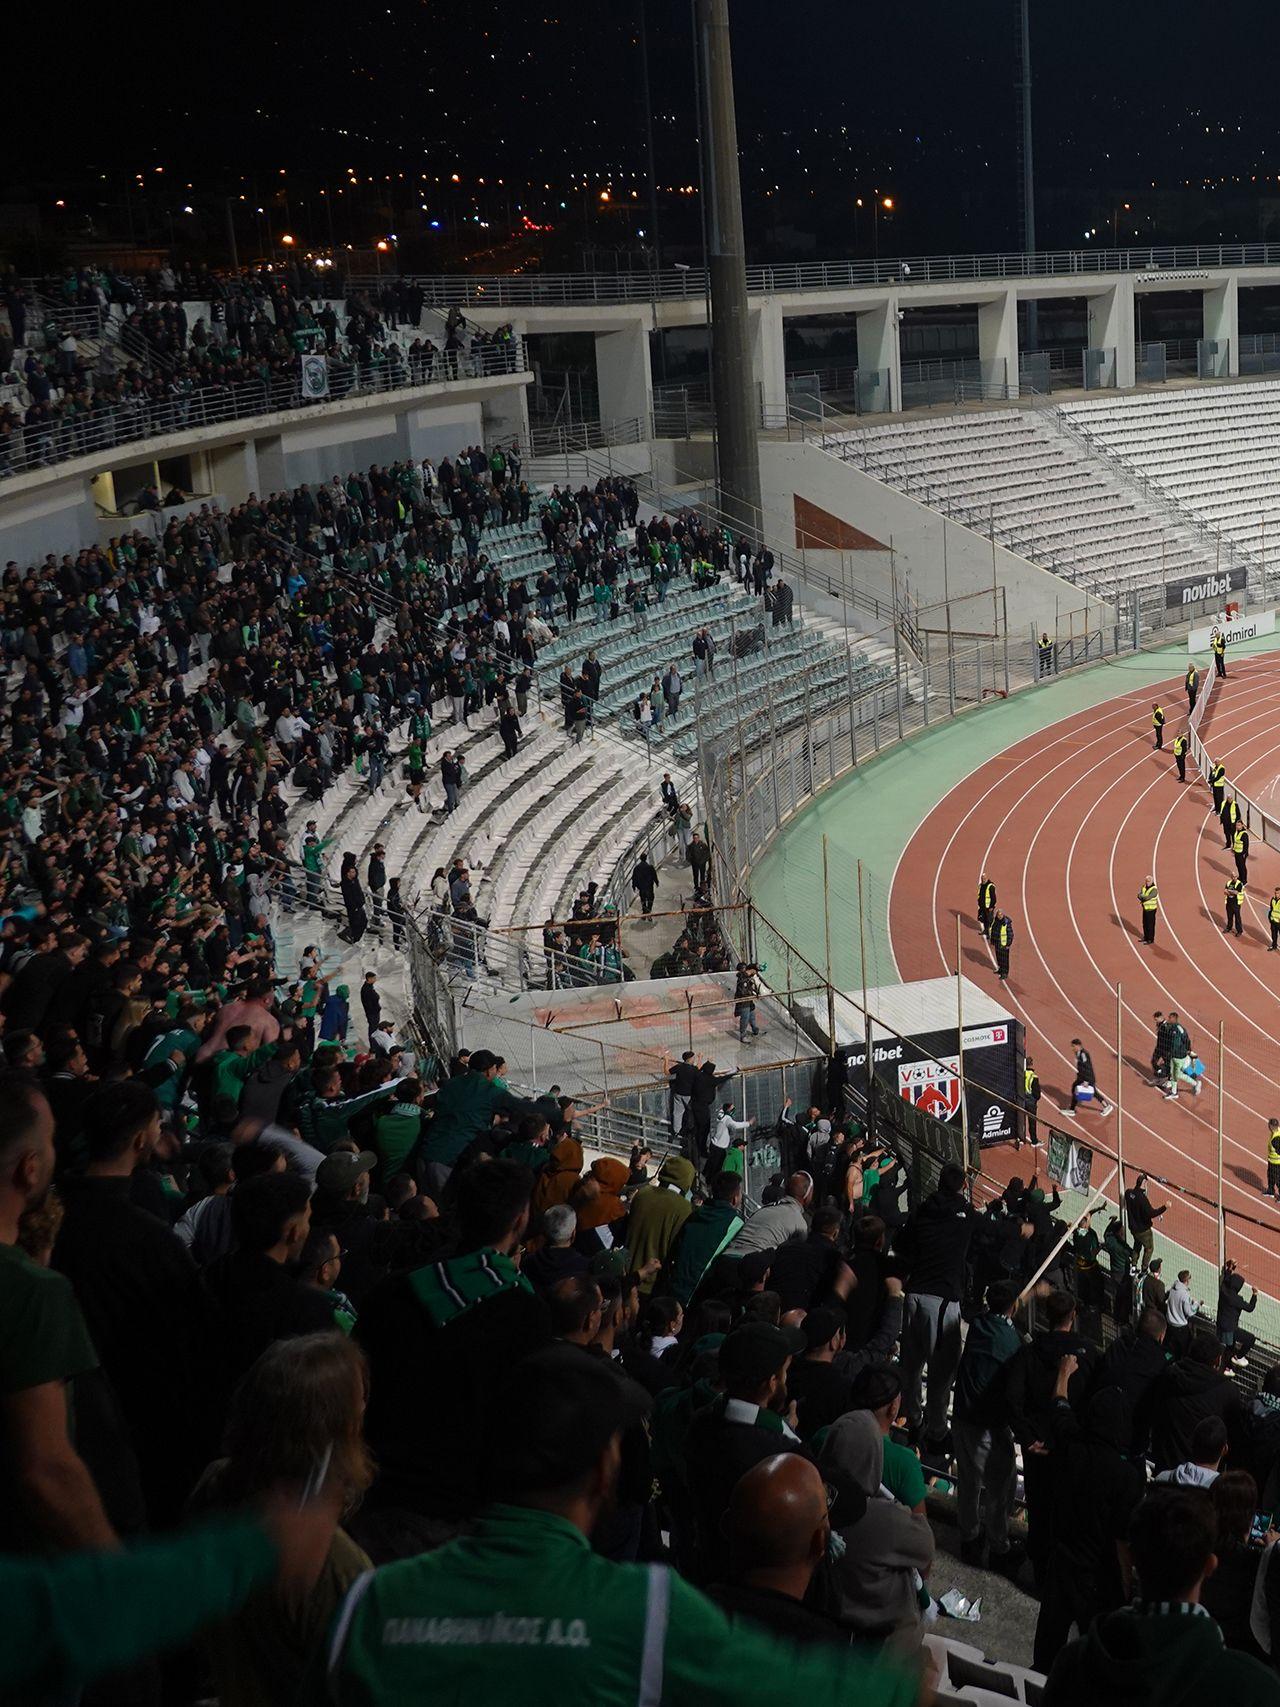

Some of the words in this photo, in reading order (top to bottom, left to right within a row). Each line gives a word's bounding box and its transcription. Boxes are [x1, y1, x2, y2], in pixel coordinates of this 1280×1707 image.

[1182, 573, 1232, 604] novibet
[963, 1034, 991, 1044] COSMOTE
[847, 1045, 903, 1067] noibet
[981, 1127, 1011, 1140] Admiral
